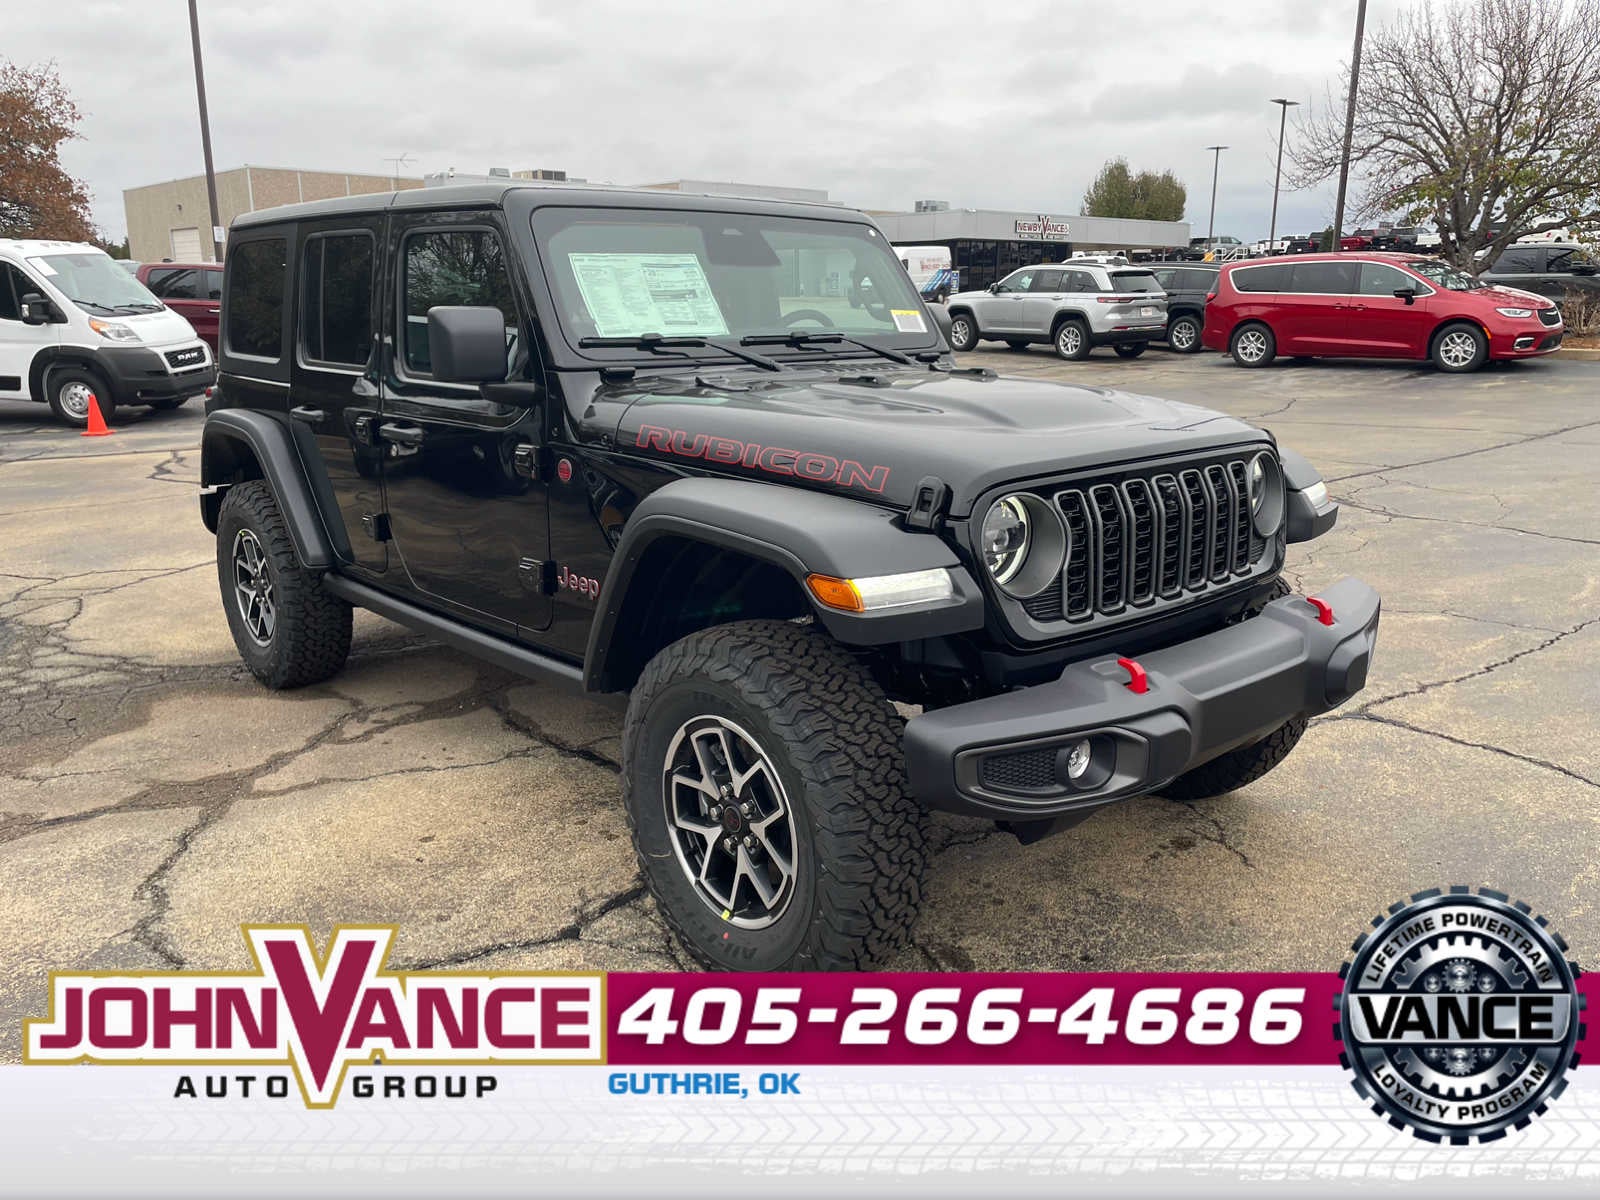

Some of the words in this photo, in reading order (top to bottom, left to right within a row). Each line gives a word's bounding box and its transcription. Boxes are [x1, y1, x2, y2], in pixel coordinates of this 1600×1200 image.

[1017, 222, 1041, 232] NEWBY
[1041, 216, 1065, 236] VANCE
[636, 424, 890, 493] RUBICON
[557, 566, 600, 600] Jeep
